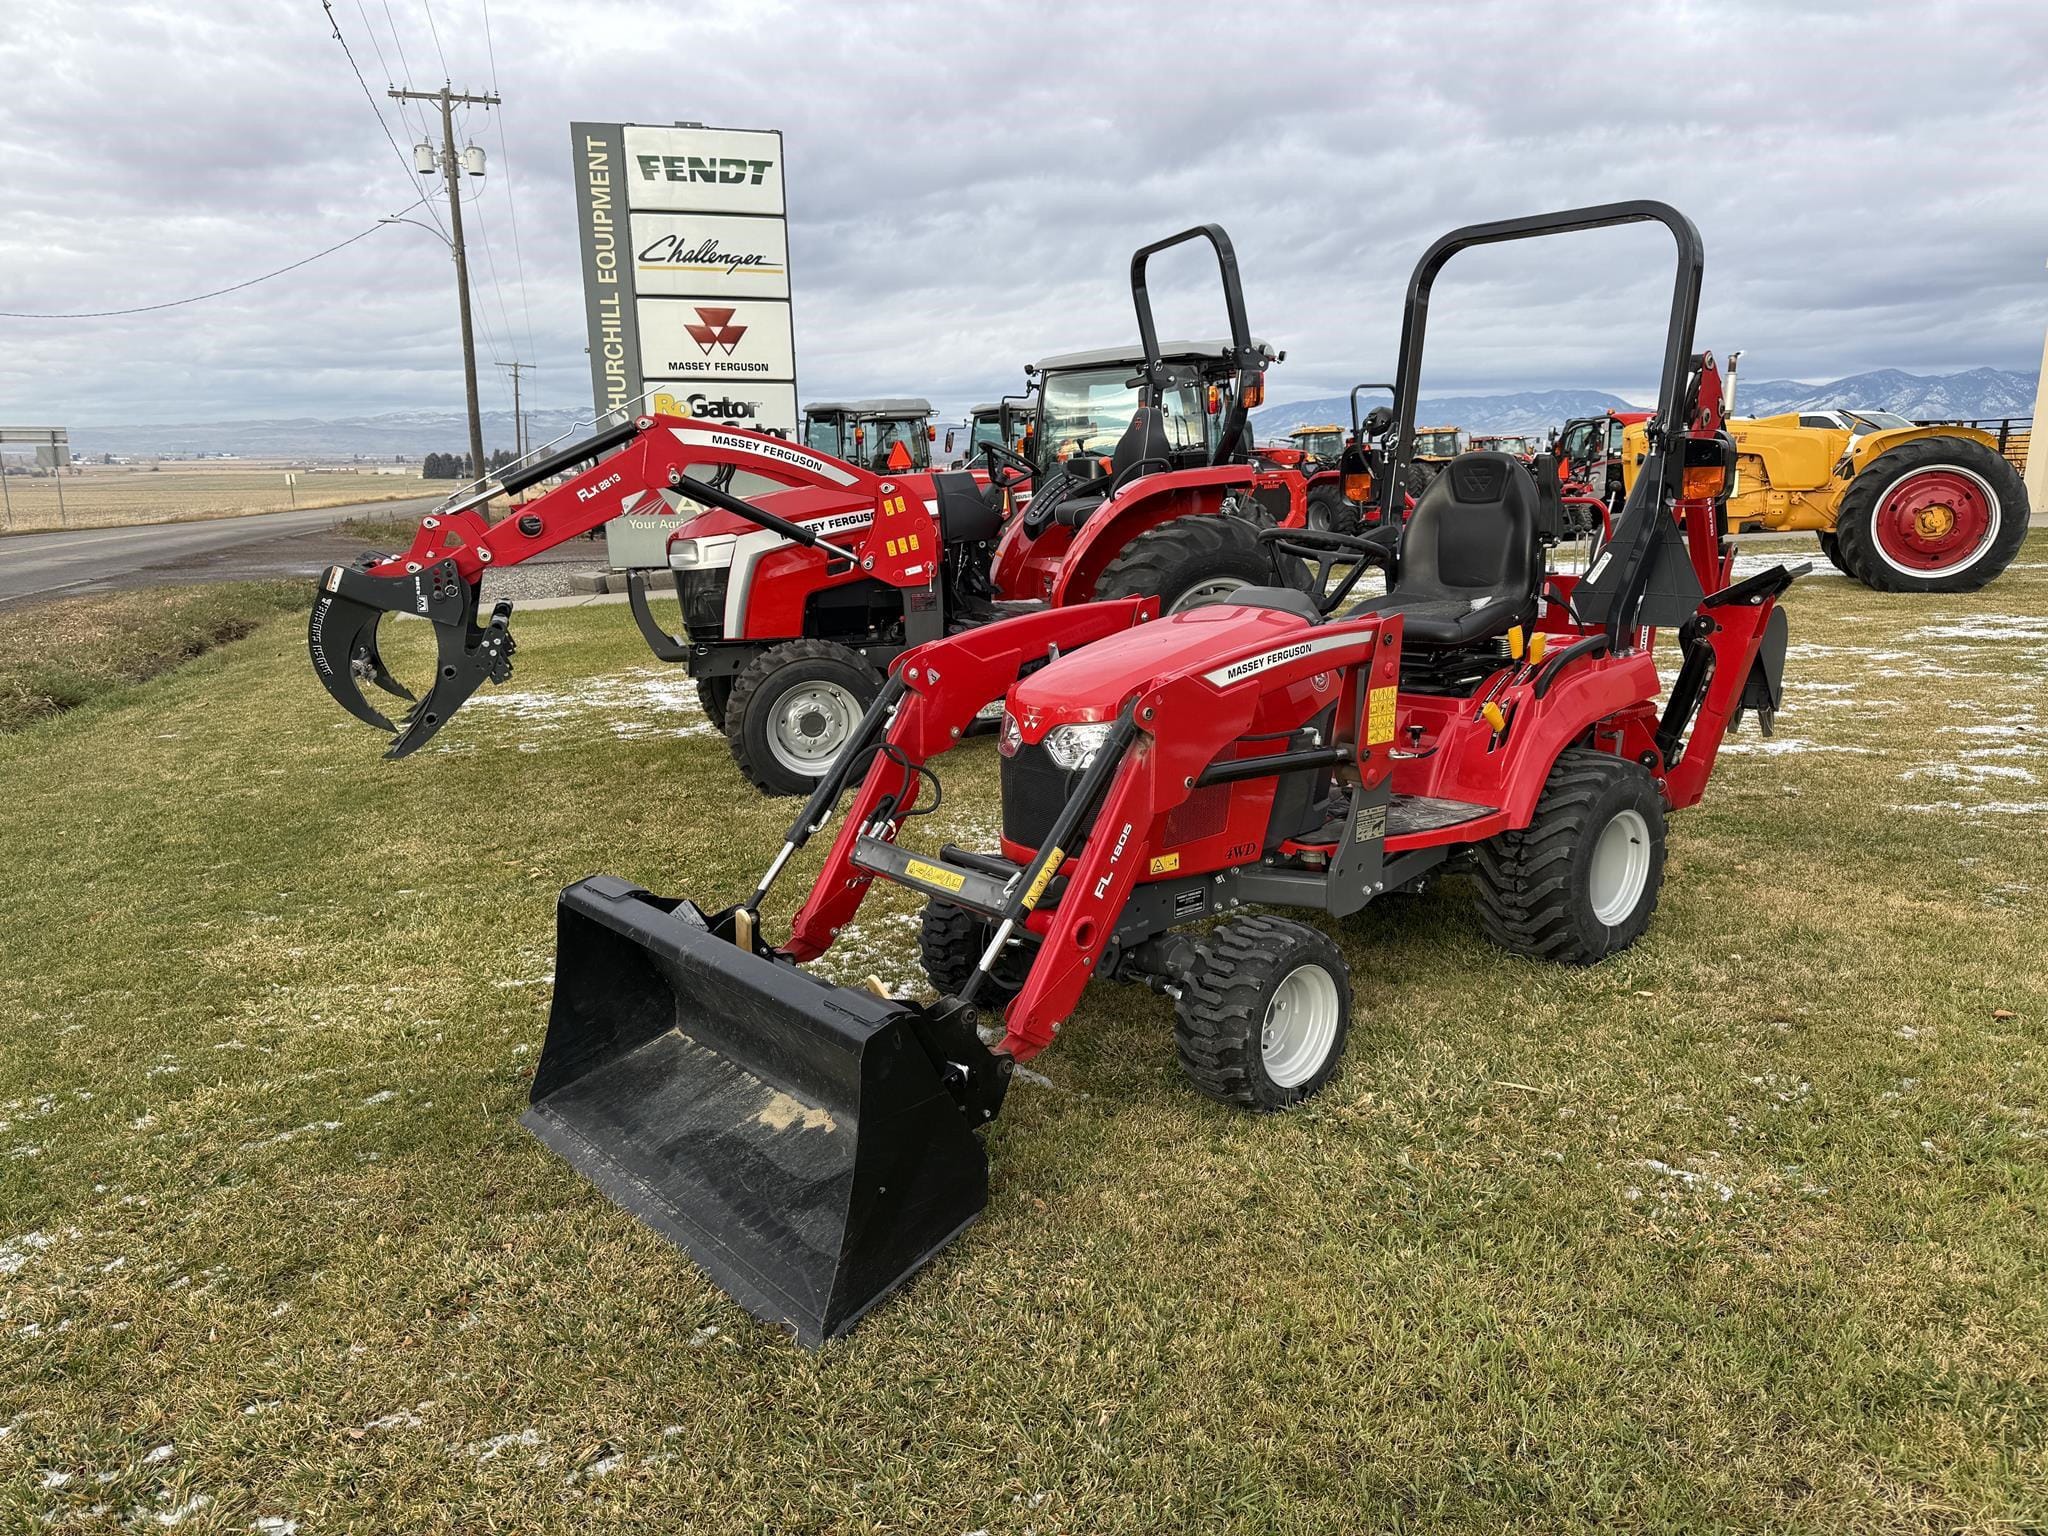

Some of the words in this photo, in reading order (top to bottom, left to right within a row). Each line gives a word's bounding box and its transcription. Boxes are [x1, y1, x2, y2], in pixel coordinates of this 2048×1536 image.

[637, 155, 773, 185] FENDT
[586, 136, 619, 284] EQUIPMENT
[638, 235, 783, 275] Challenger
[668, 362, 711, 371] MASSEY
[715, 362, 769, 372] FERGUSON
[654, 393, 762, 418] RoGator
[712, 435, 760, 451] MASSEY
[763, 445, 823, 472] FERGUSON
[576, 484, 600, 502] FLX
[598, 473, 622, 491] 2813
[629, 519, 656, 530] Your
[1227, 658, 1265, 679] MASSEY
[1267, 644, 1312, 665] FERGUSON
[1094, 871, 1114, 899] FL
[1110, 822, 1133, 864] 1805
[1225, 842, 1257, 860] 4WD
